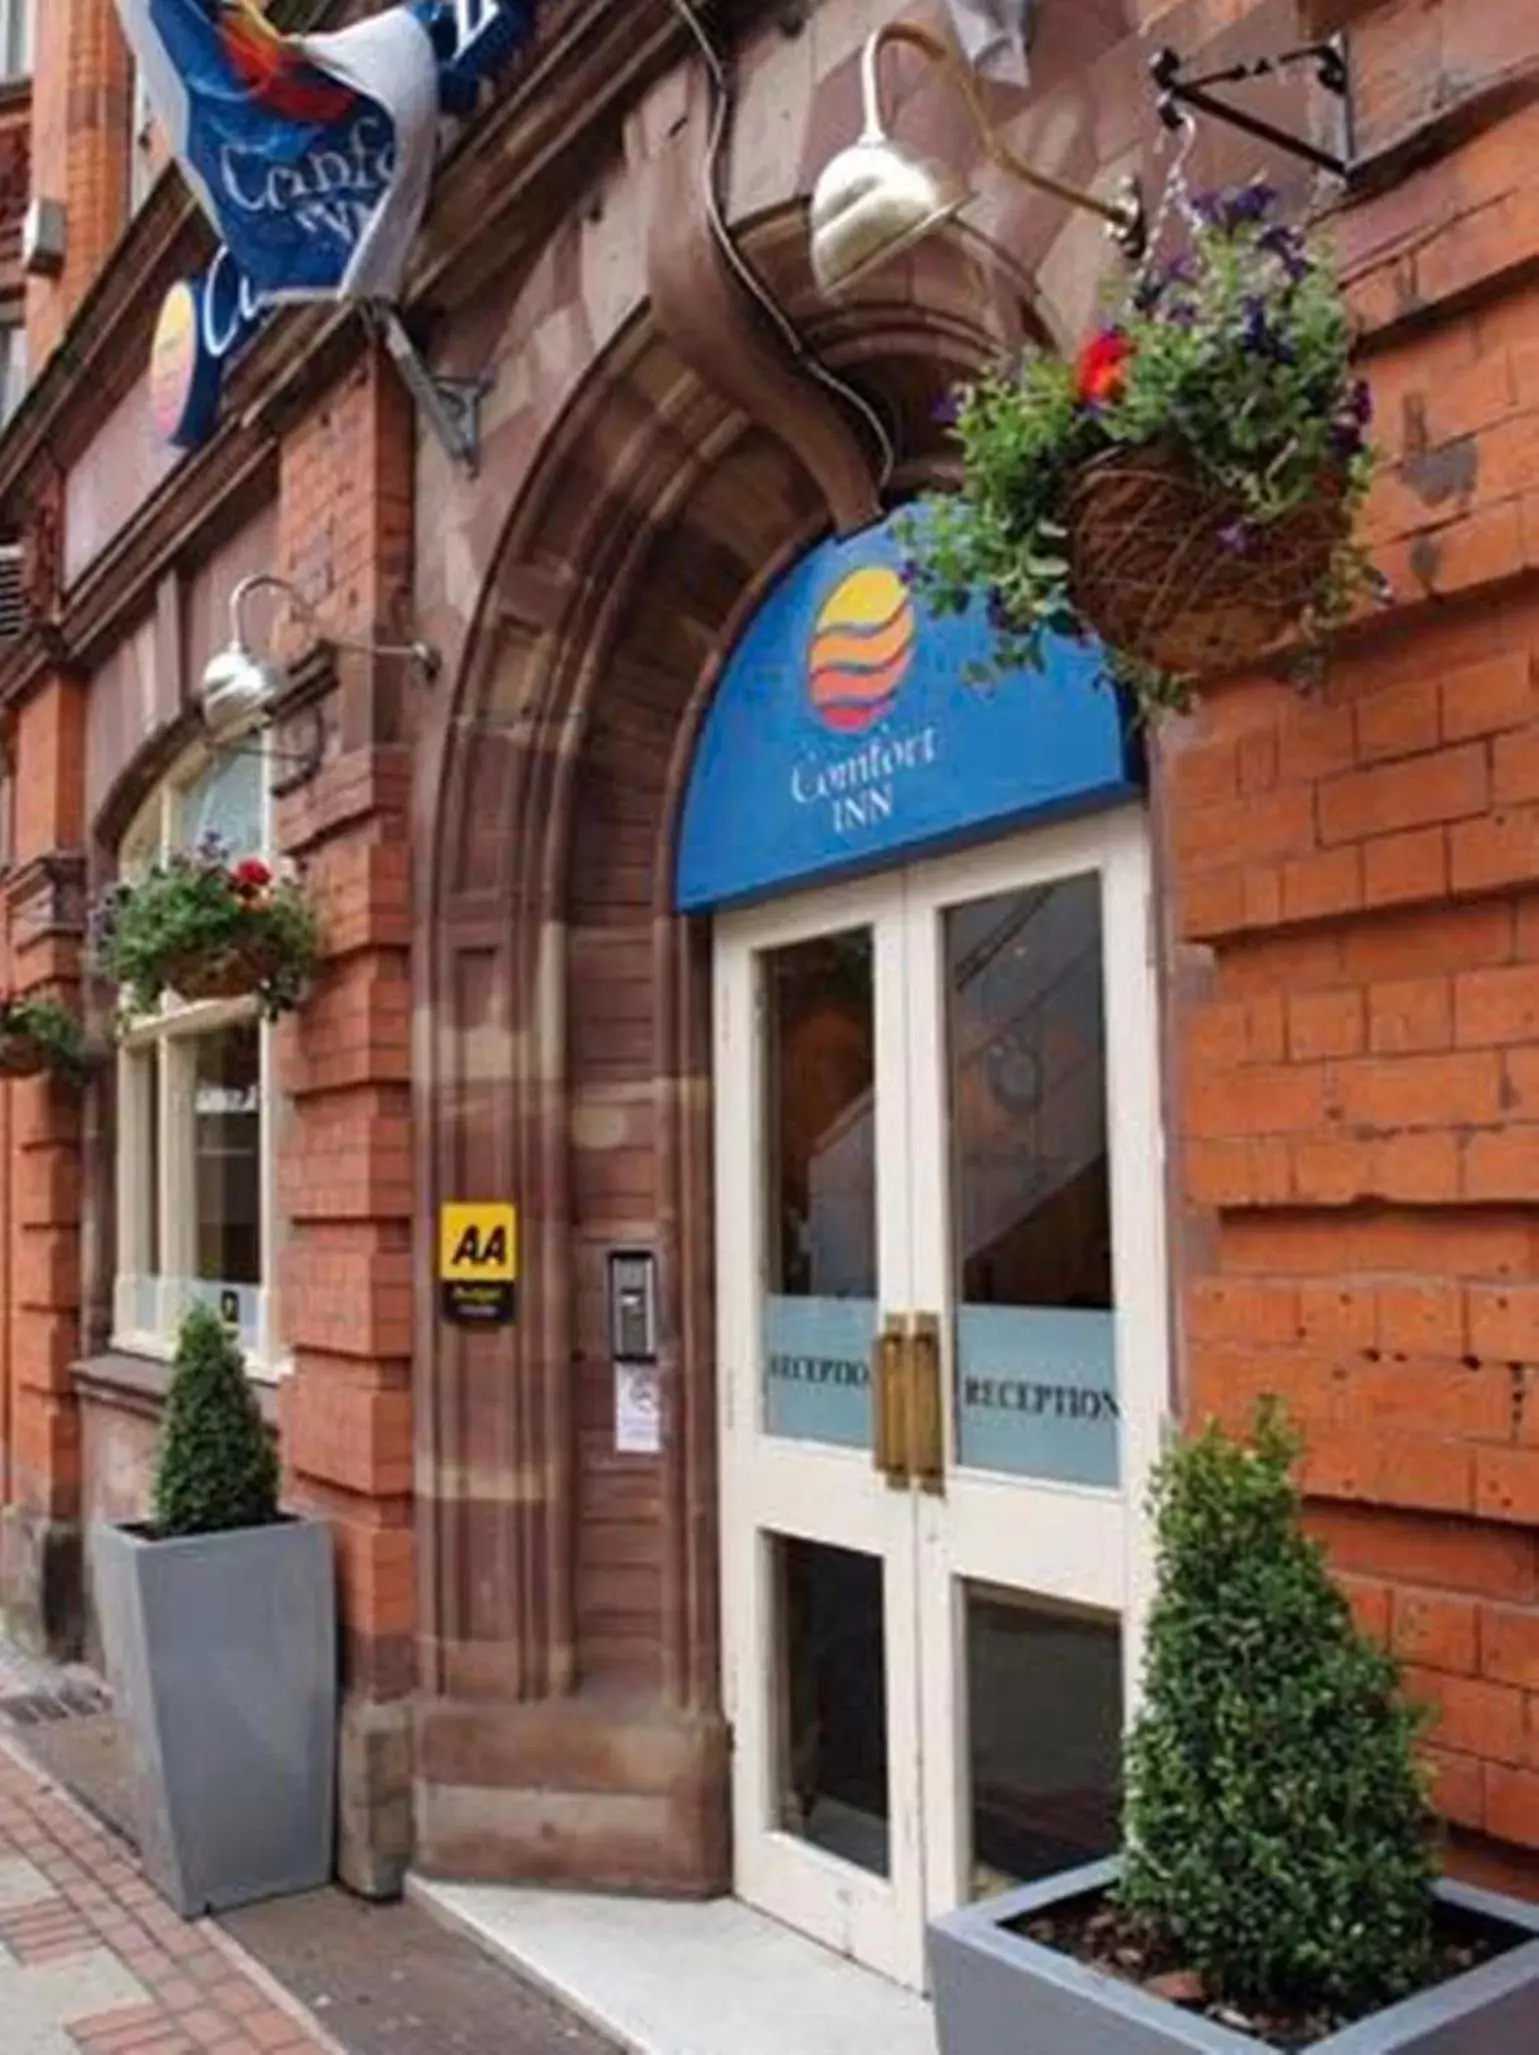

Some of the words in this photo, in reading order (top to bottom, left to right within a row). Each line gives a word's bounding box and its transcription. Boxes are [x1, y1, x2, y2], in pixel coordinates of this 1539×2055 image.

[791, 726, 936, 804] Comfort
[832, 782, 892, 833] INN
[451, 1223, 507, 1266] AA
[769, 1354, 870, 1388] RECEPTIO
[965, 1376, 1121, 1420] RECEPTION
